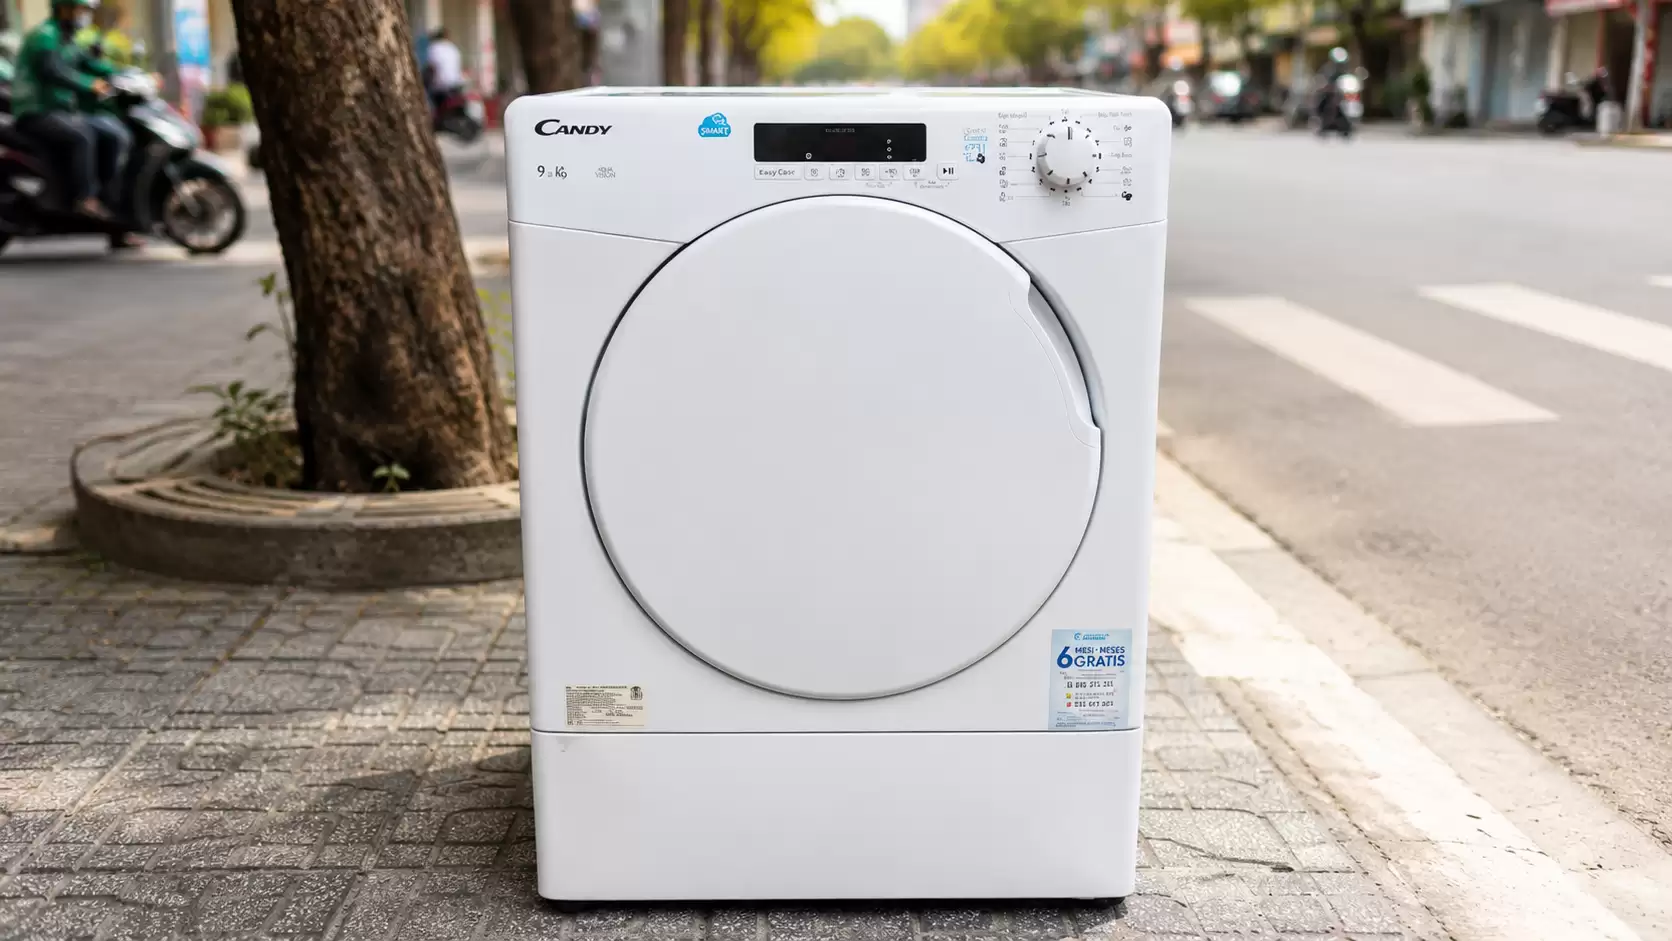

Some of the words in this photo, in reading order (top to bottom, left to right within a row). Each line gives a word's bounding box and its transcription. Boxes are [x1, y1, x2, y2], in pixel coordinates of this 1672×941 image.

[534, 119, 612, 136] CANDY
[537, 165, 545, 178] 9
[1057, 646, 1073, 669] 6
[1074, 654, 1126, 667] GRATIS
